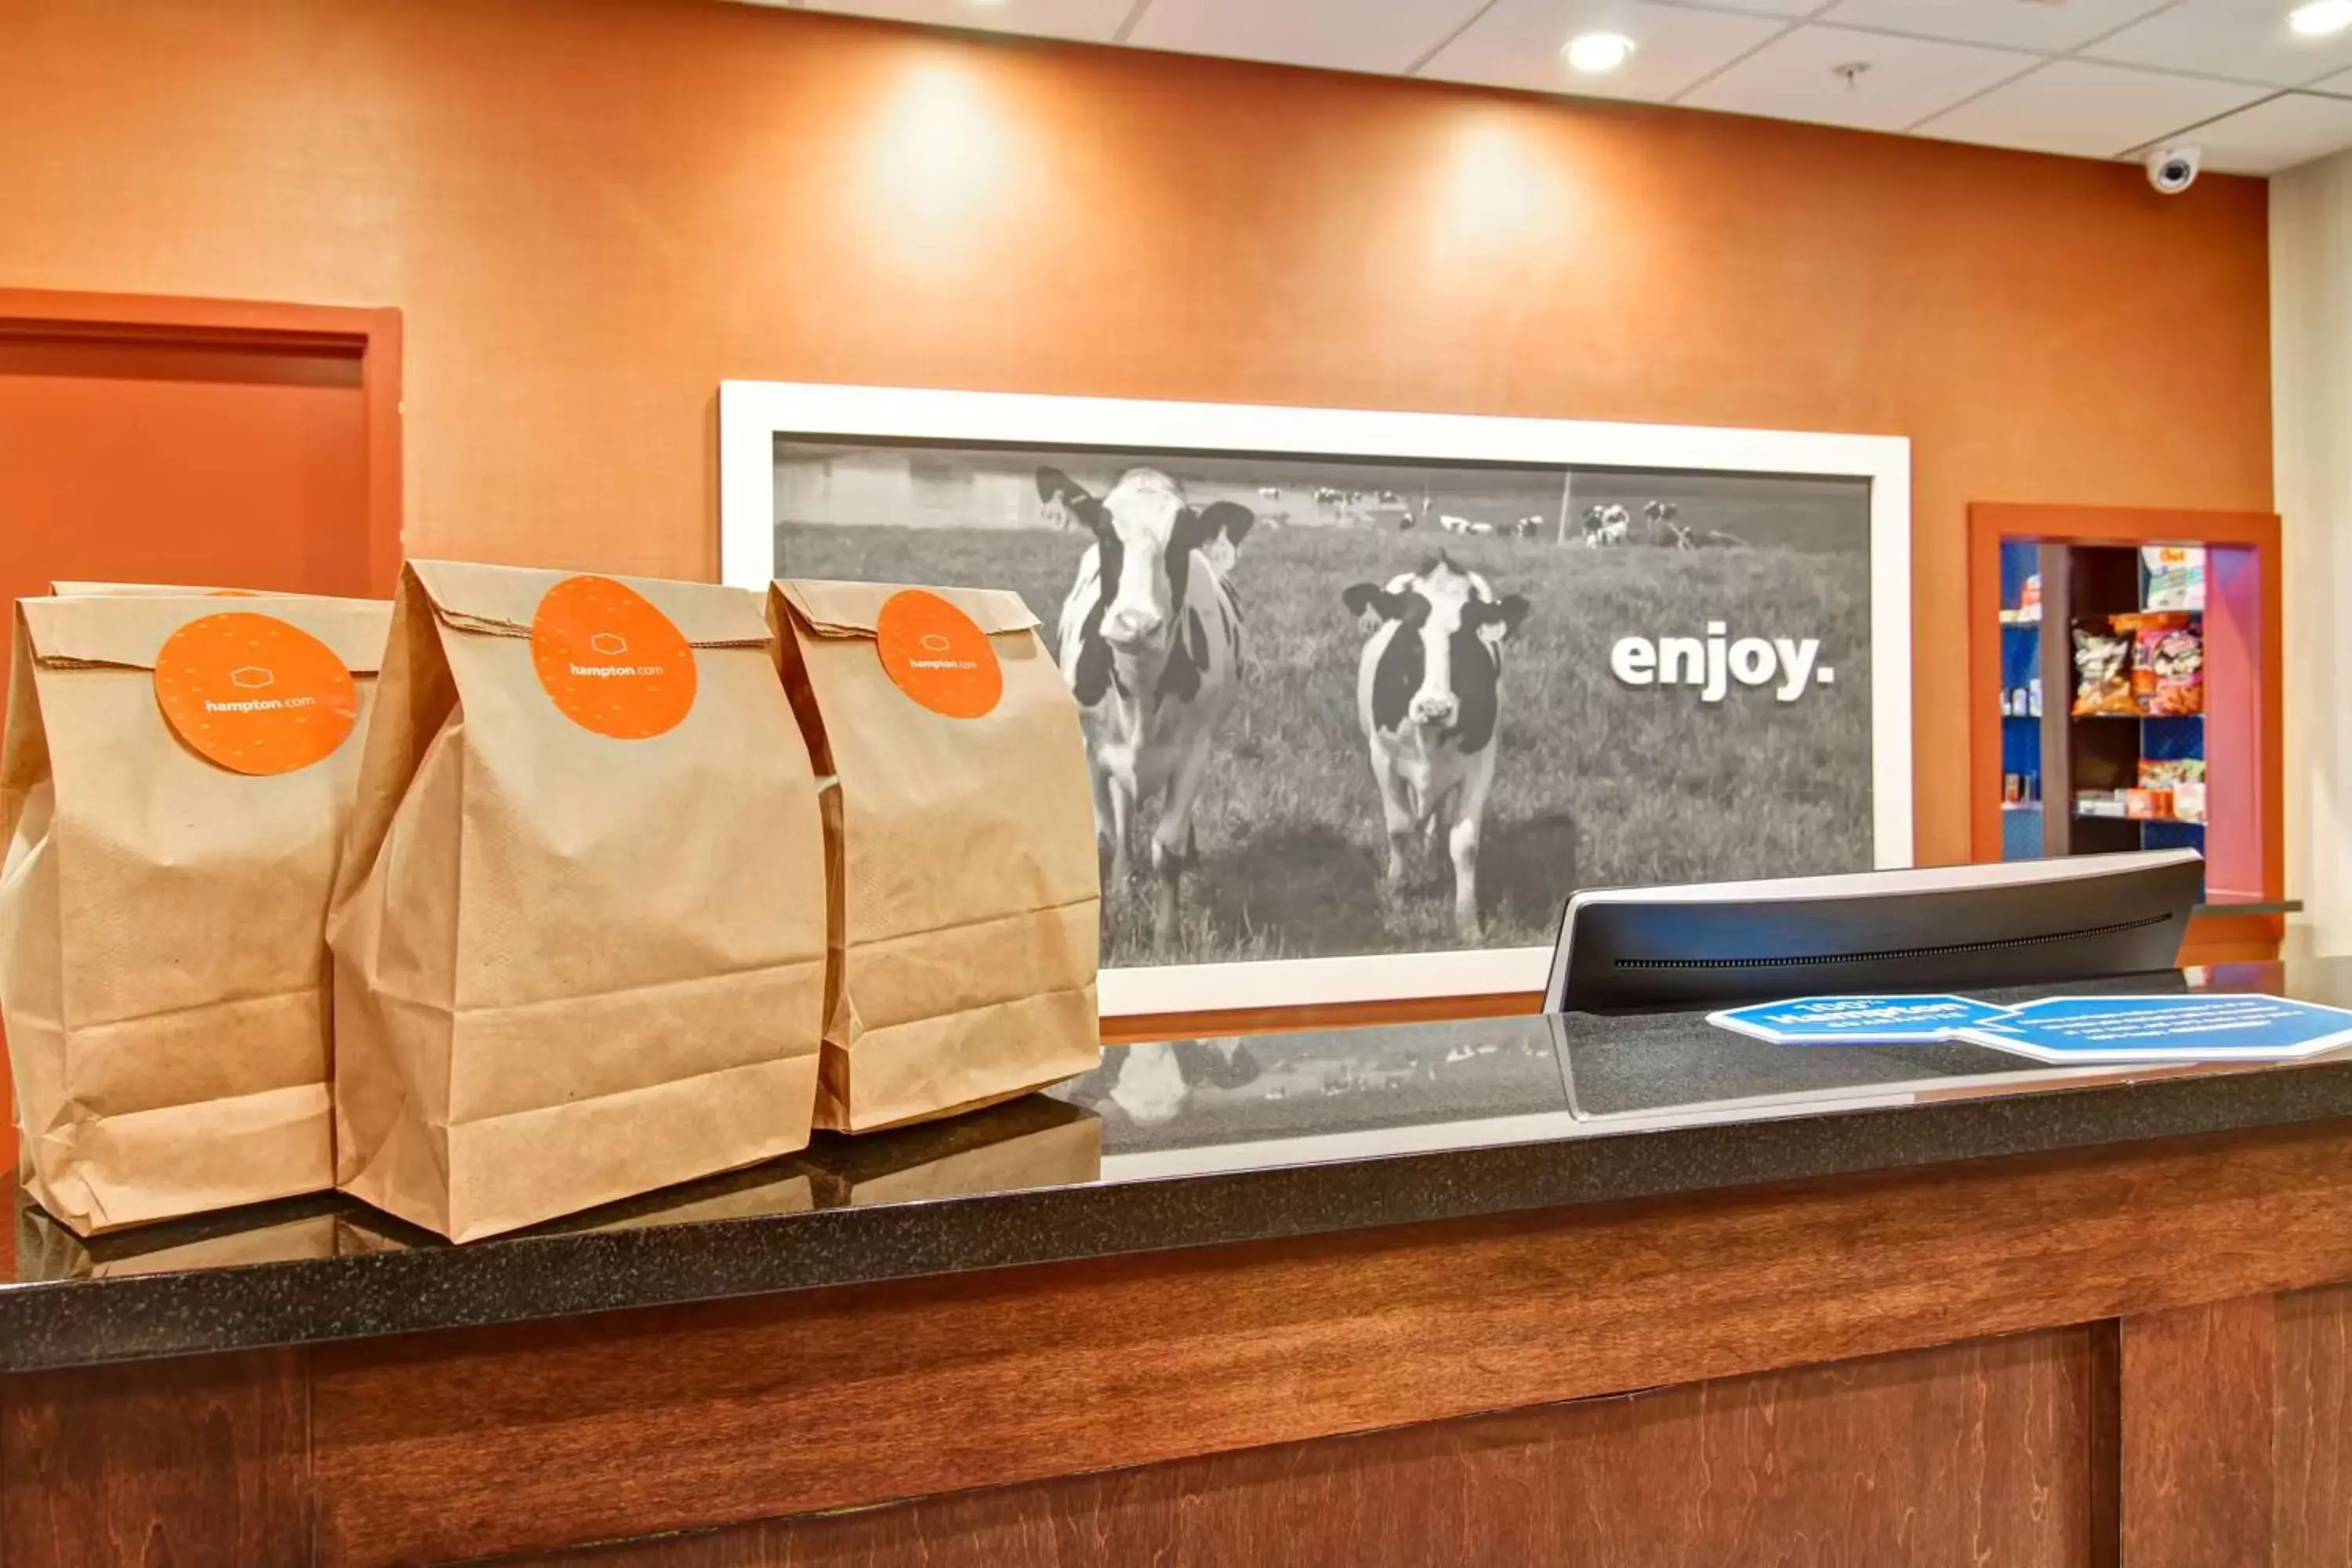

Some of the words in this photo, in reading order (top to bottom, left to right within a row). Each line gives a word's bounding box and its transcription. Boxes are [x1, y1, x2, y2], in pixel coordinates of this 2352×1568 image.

[909, 658, 978, 670] hampton.com
[1611, 621, 1835, 702] enjoy.
[569, 662, 664, 677] hampton.com
[205, 697, 315, 713] hampton.com
